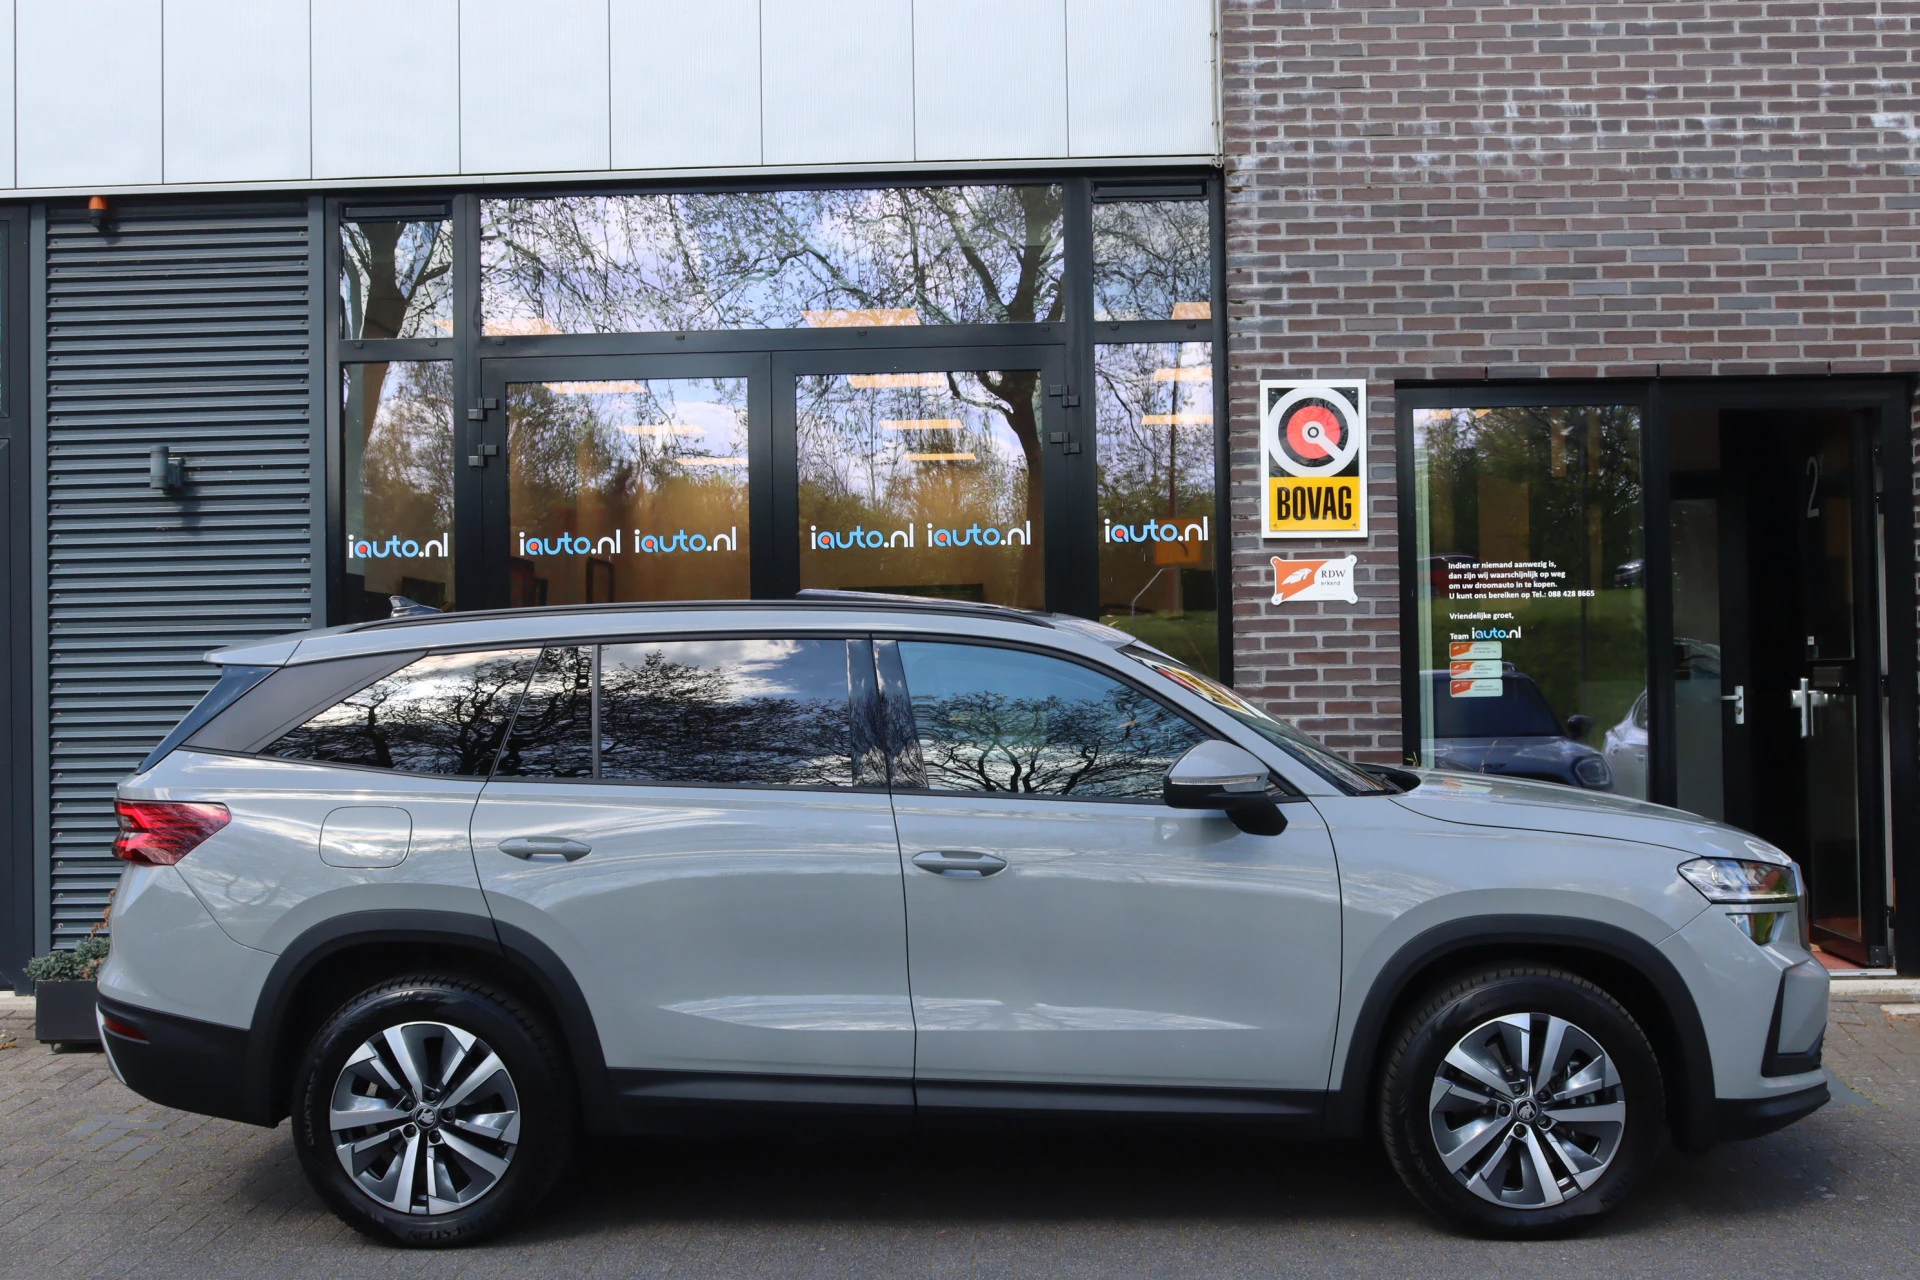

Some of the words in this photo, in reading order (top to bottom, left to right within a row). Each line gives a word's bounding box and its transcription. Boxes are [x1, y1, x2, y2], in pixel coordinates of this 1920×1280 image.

[1277, 485, 1352, 521] BOVAG
[810, 522, 914, 549] iauto.nl
[926, 517, 1031, 548] iauto.nl
[1104, 516, 1209, 543] iauto.nl
[348, 532, 449, 559] iauto.nl
[519, 530, 621, 556] iauto.nl
[634, 526, 737, 553] iauto.nl
[1514, 560, 1547, 569] aanwezig
[1548, 560, 1557, 568] is,
[1321, 570, 1346, 578] RDW
[1463, 572, 1476, 580] zijn
[1477, 571, 1489, 580] wij
[1490, 571, 1538, 580] waarschijnlijk
[1550, 571, 1566, 579] weg
[1533, 581, 1558, 589] kopen.
[1488, 591, 1519, 599] bereiken
[1449, 612, 1492, 620] Vriendelijke
[1492, 612, 1514, 620] groet,
[1471, 626, 1522, 639] iauto.nl
